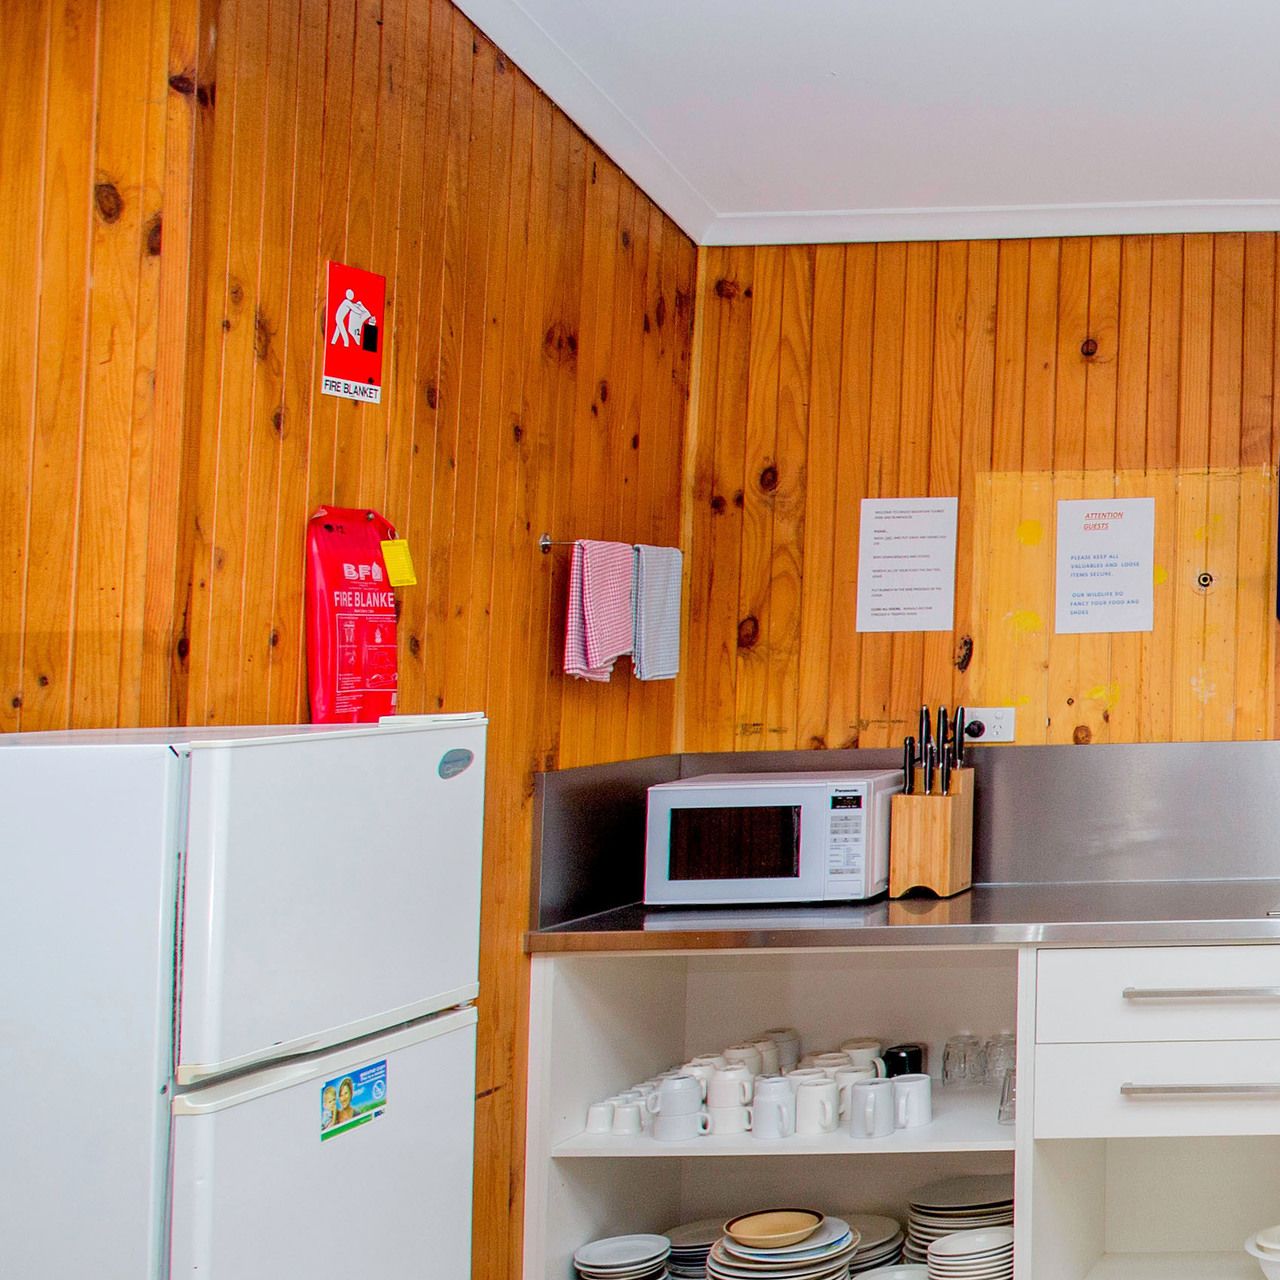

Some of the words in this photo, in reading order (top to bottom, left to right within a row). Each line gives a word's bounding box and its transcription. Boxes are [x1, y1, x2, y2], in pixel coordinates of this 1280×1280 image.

[324, 379, 342, 393] FIRE
[343, 382, 379, 399] BLANKET
[1084, 511, 1124, 520] ATTENTION
[1082, 523, 1109, 531] GUESTS
[333, 591, 353, 607] FIRE
